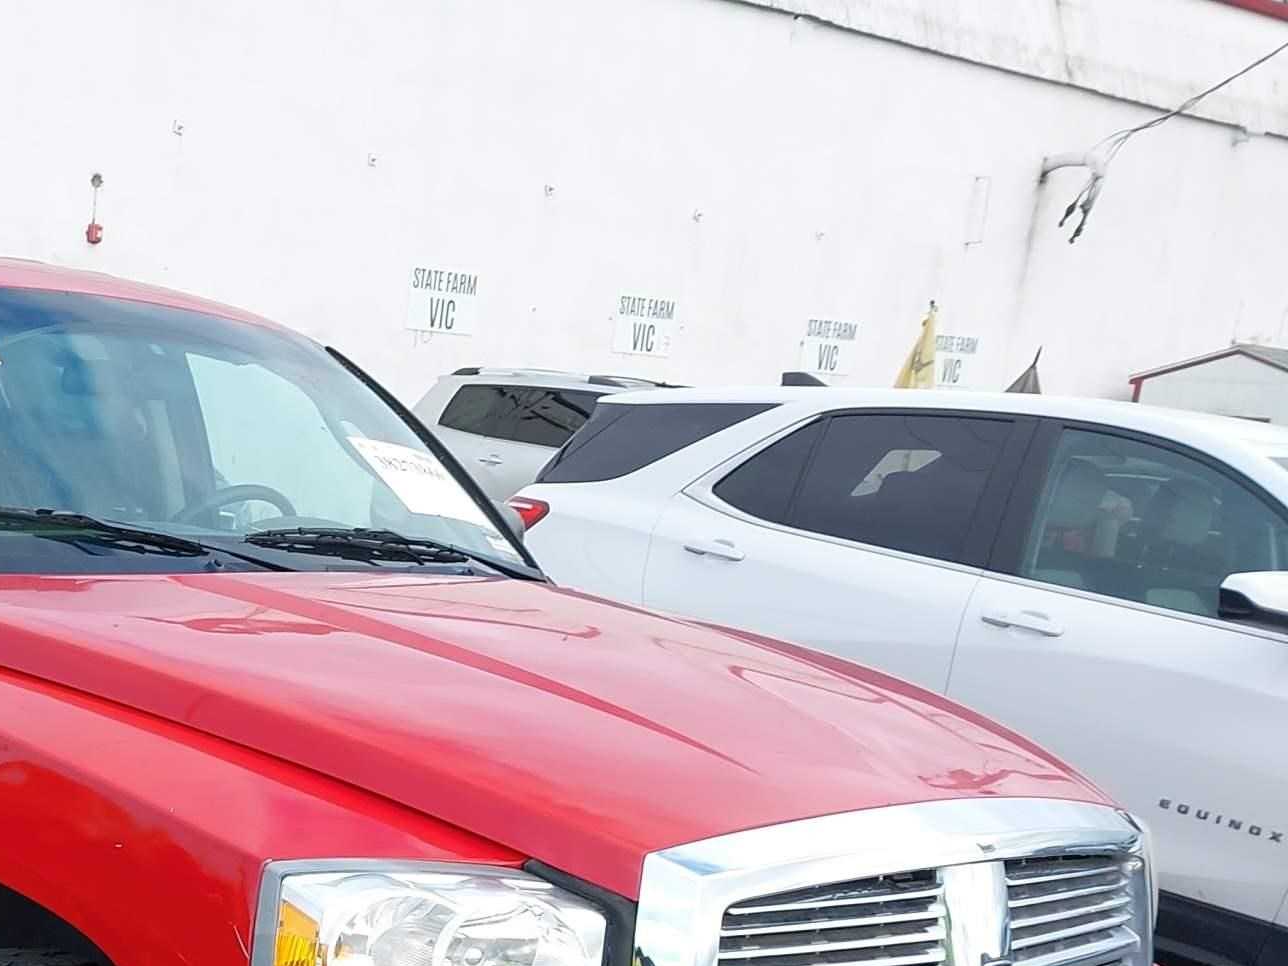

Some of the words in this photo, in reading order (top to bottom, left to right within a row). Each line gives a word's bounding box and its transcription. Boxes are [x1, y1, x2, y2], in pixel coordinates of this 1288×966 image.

[412, 267, 444, 292] STATE
[445, 271, 478, 296] FARM
[430, 296, 456, 330] VIC
[618, 295, 647, 317] STATE
[648, 298, 676, 321] FARM
[632, 322, 656, 352] VIC
[807, 319, 832, 338] STATE
[833, 320, 858, 340] FARM
[817, 343, 839, 371] VIC
[941, 358, 962, 384] VIC
[1158, 799, 1283, 842] EQUINOX
